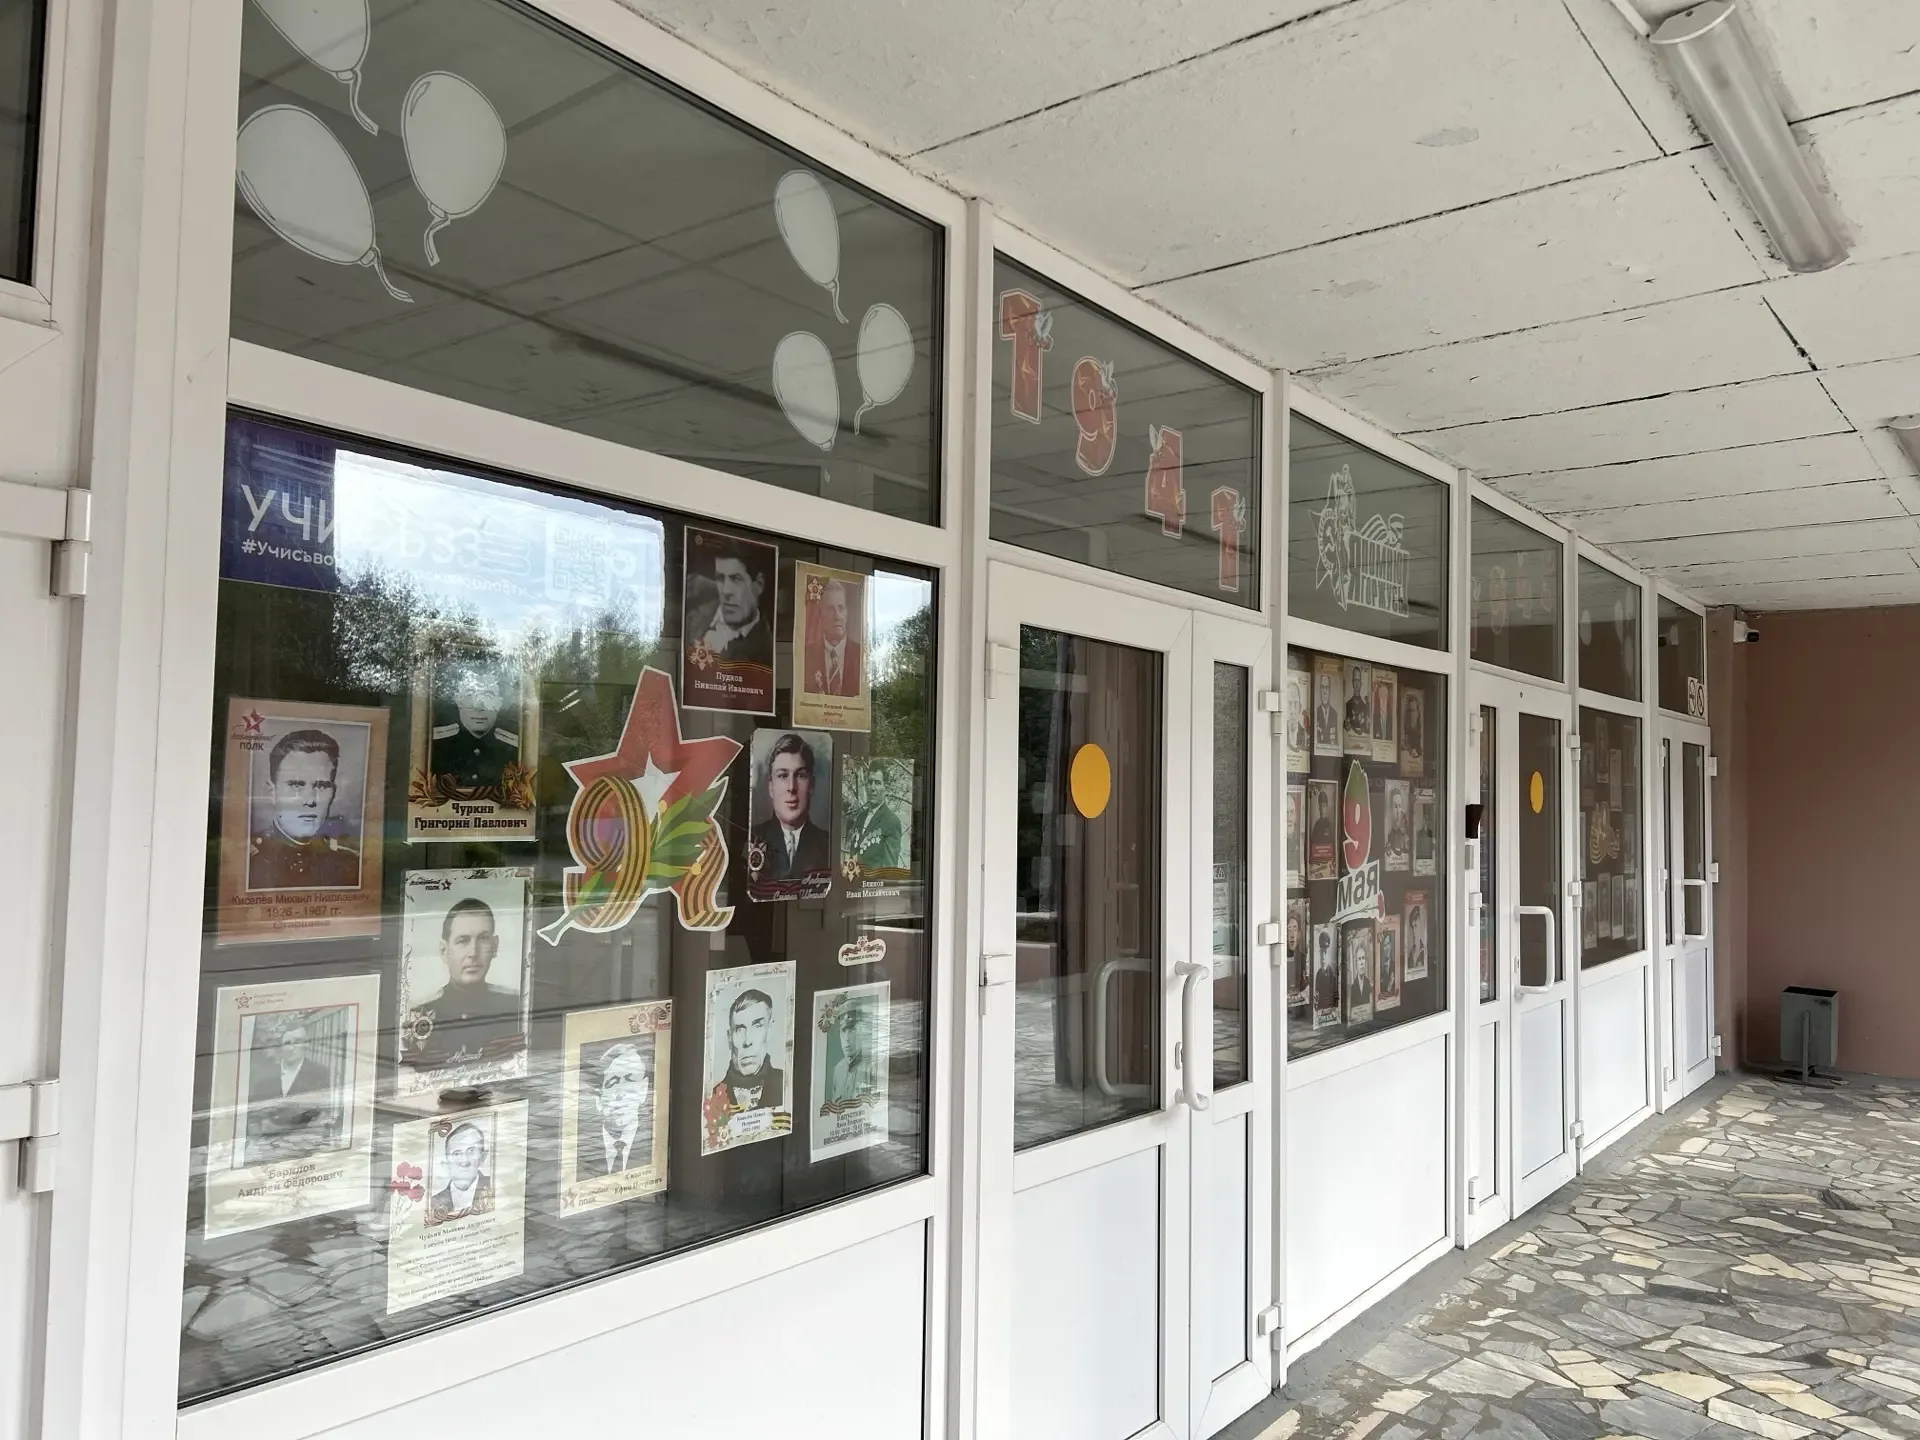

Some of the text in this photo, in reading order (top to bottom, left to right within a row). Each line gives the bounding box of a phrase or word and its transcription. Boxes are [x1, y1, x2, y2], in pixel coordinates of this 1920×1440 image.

[715, 671, 743, 682] Пудков
[694, 680, 764, 695] Николай Иванович
[451, 802, 494, 816] Чуркин
[414, 816, 527, 831] Григорий Павлович
[275, 893, 312, 905] Михаил
[846, 890, 861, 899] Иван
[266, 907, 293, 918] 1926
[237, 1169, 344, 1198] Андрей Фёдорович
